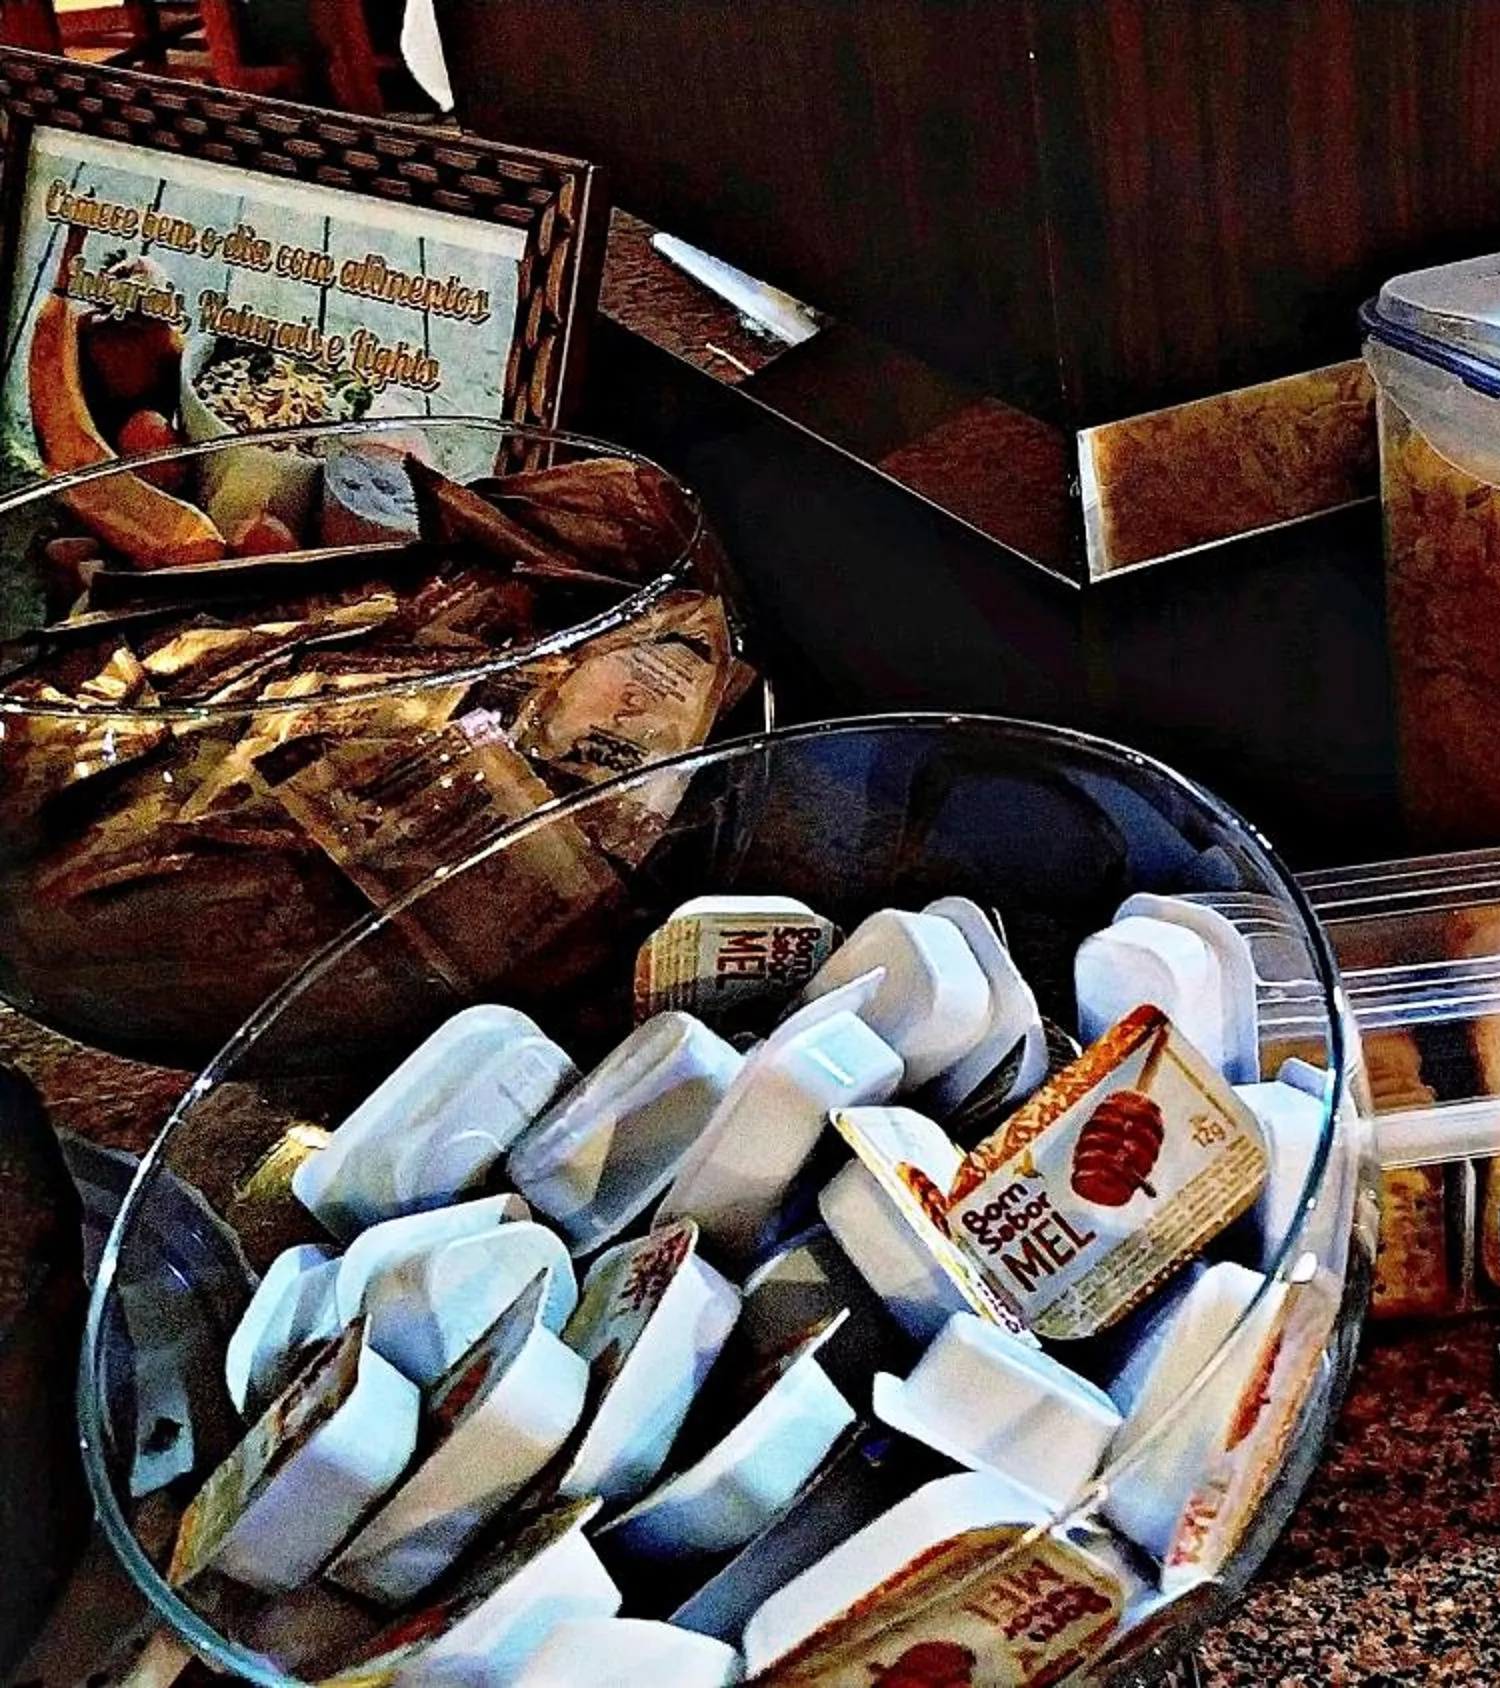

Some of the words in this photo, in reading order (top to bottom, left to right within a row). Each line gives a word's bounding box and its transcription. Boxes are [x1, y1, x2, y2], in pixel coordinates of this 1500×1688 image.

[46, 179, 140, 238] Comece
[140, 203, 199, 253] bem
[200, 227, 223, 258] o
[222, 223, 273, 271] dia
[276, 245, 337, 288] com
[338, 253, 491, 324] alimentos
[716, 930, 769, 990] MEL
[961, 1182, 1029, 1235] Bom
[1000, 1210, 1097, 1293] MEL
